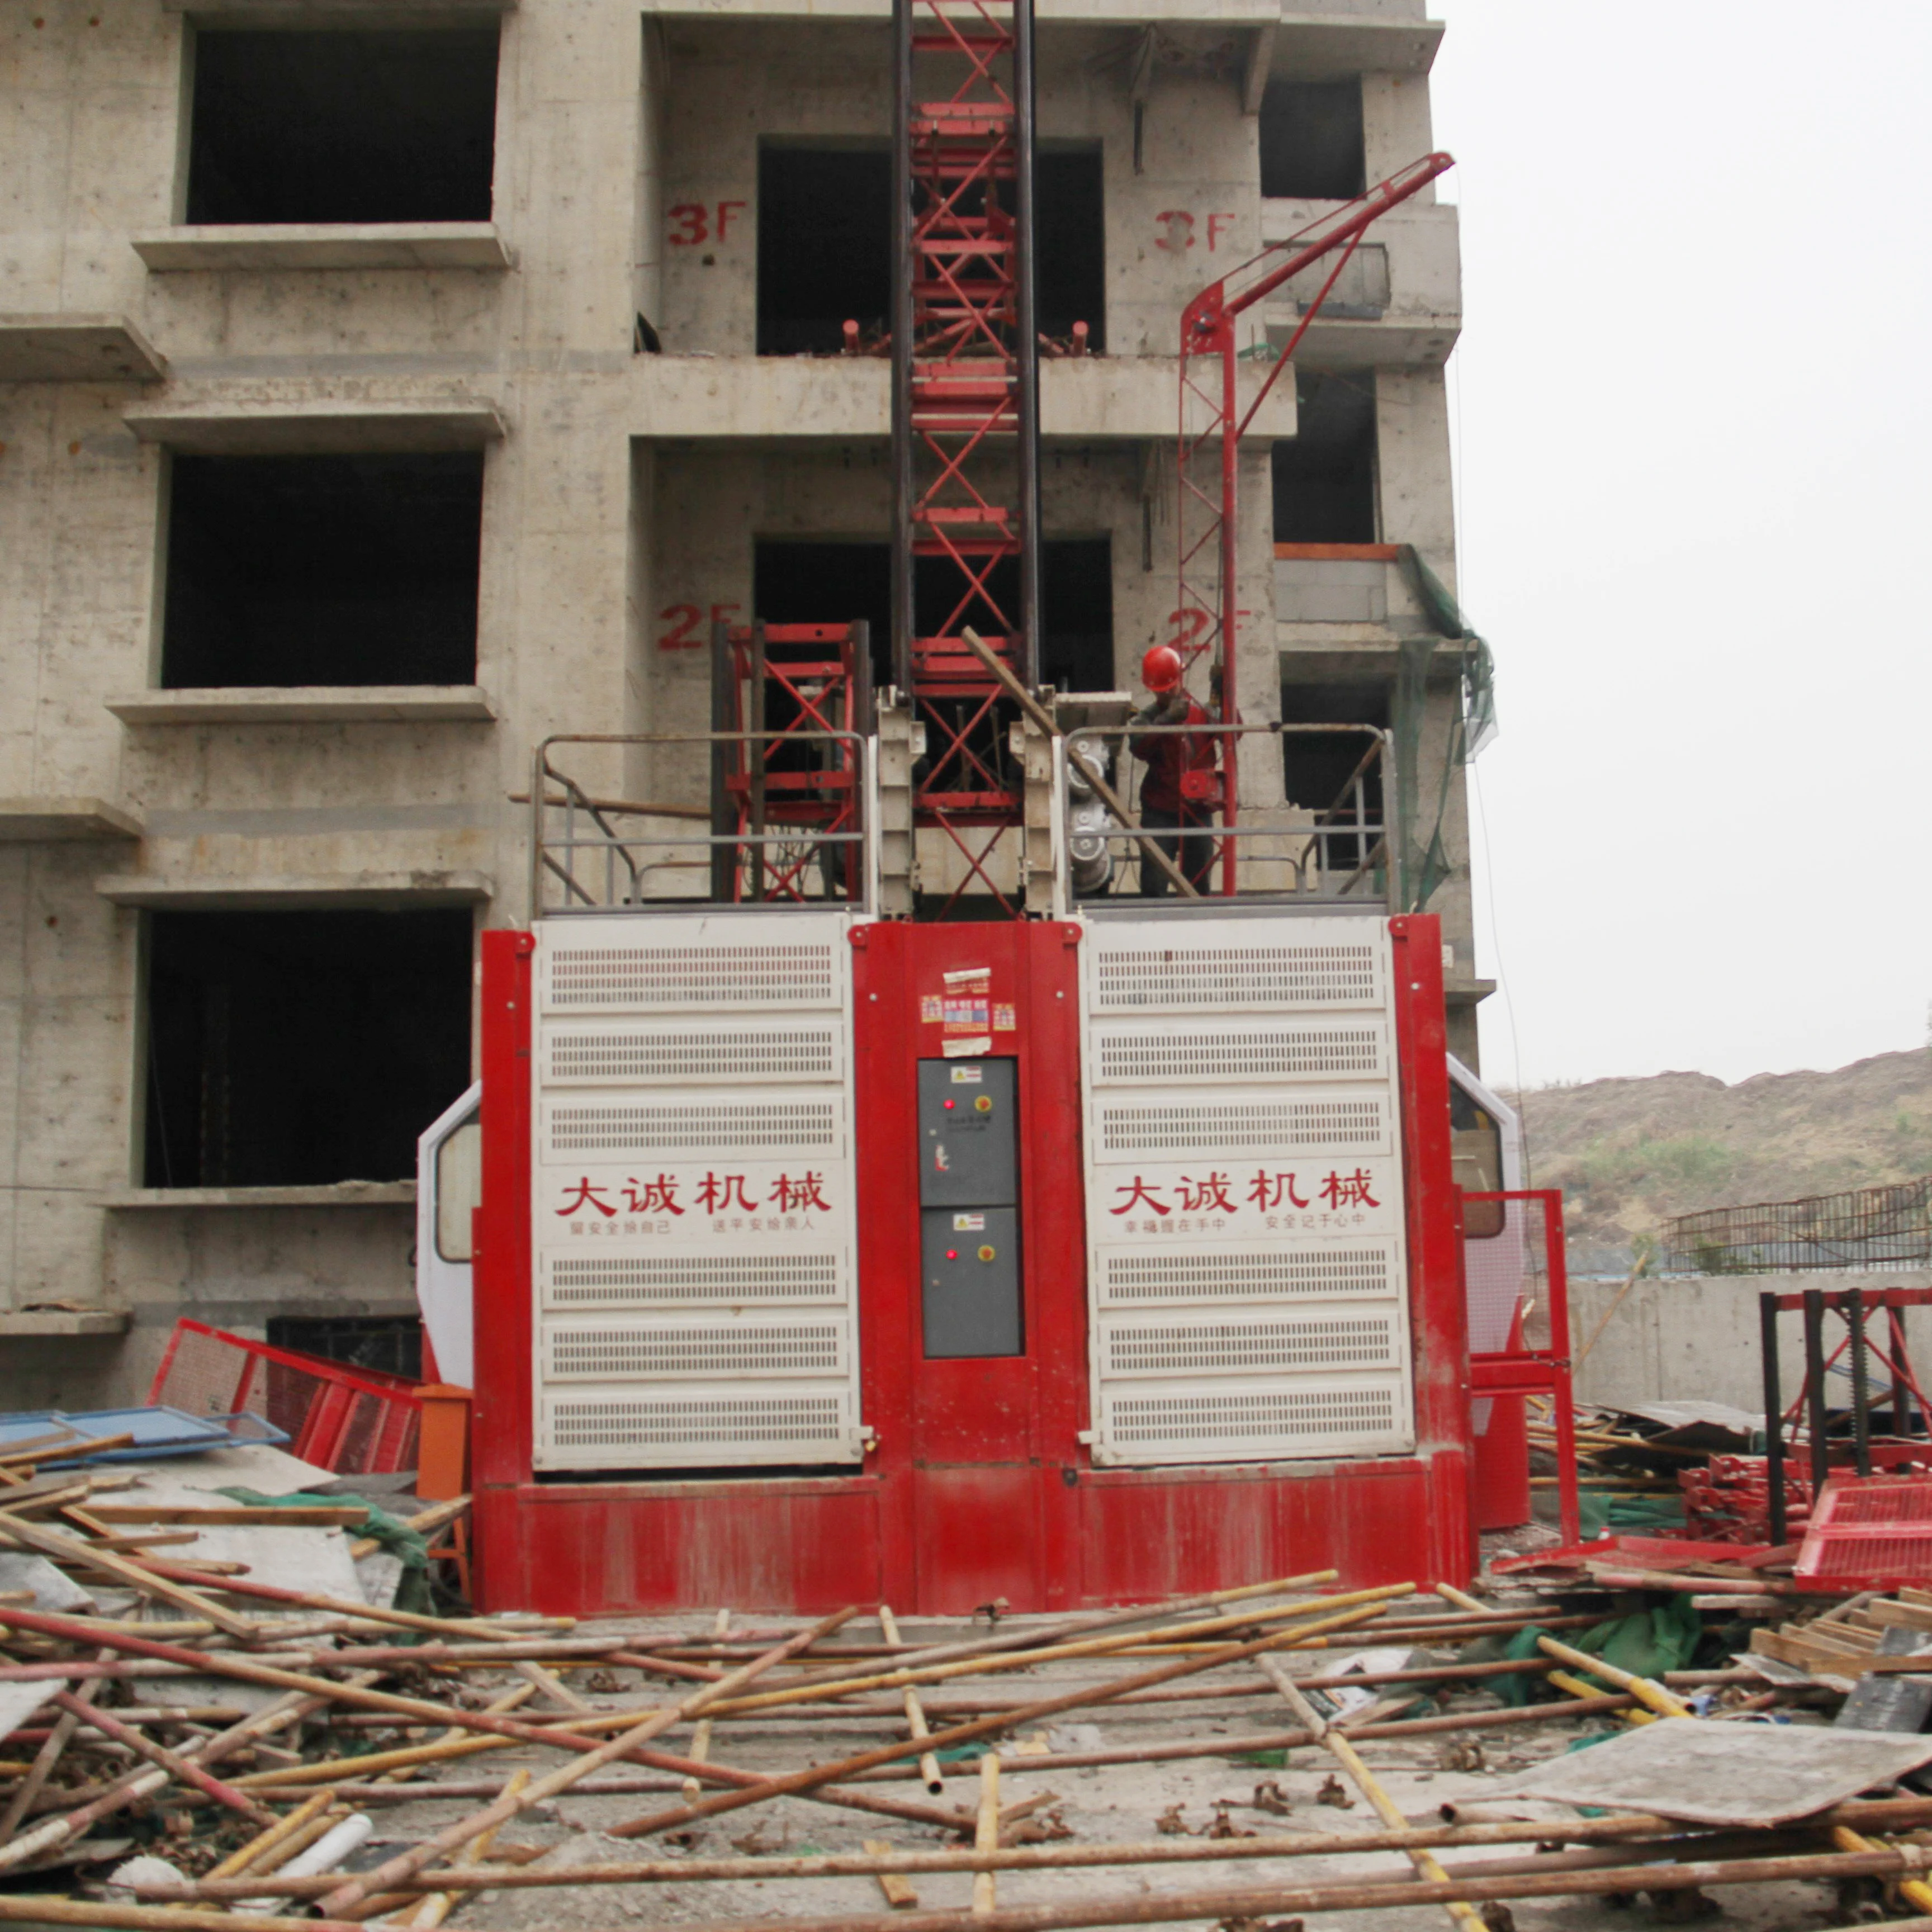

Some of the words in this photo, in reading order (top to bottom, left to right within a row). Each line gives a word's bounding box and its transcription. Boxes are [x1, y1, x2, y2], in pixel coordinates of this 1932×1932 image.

[667, 201, 747, 245] 3F
[1155, 210, 1235, 253] 3F
[555, 1171, 832, 1218] 大诚机械
[1109, 1168, 1380, 1215] 大诚机械
